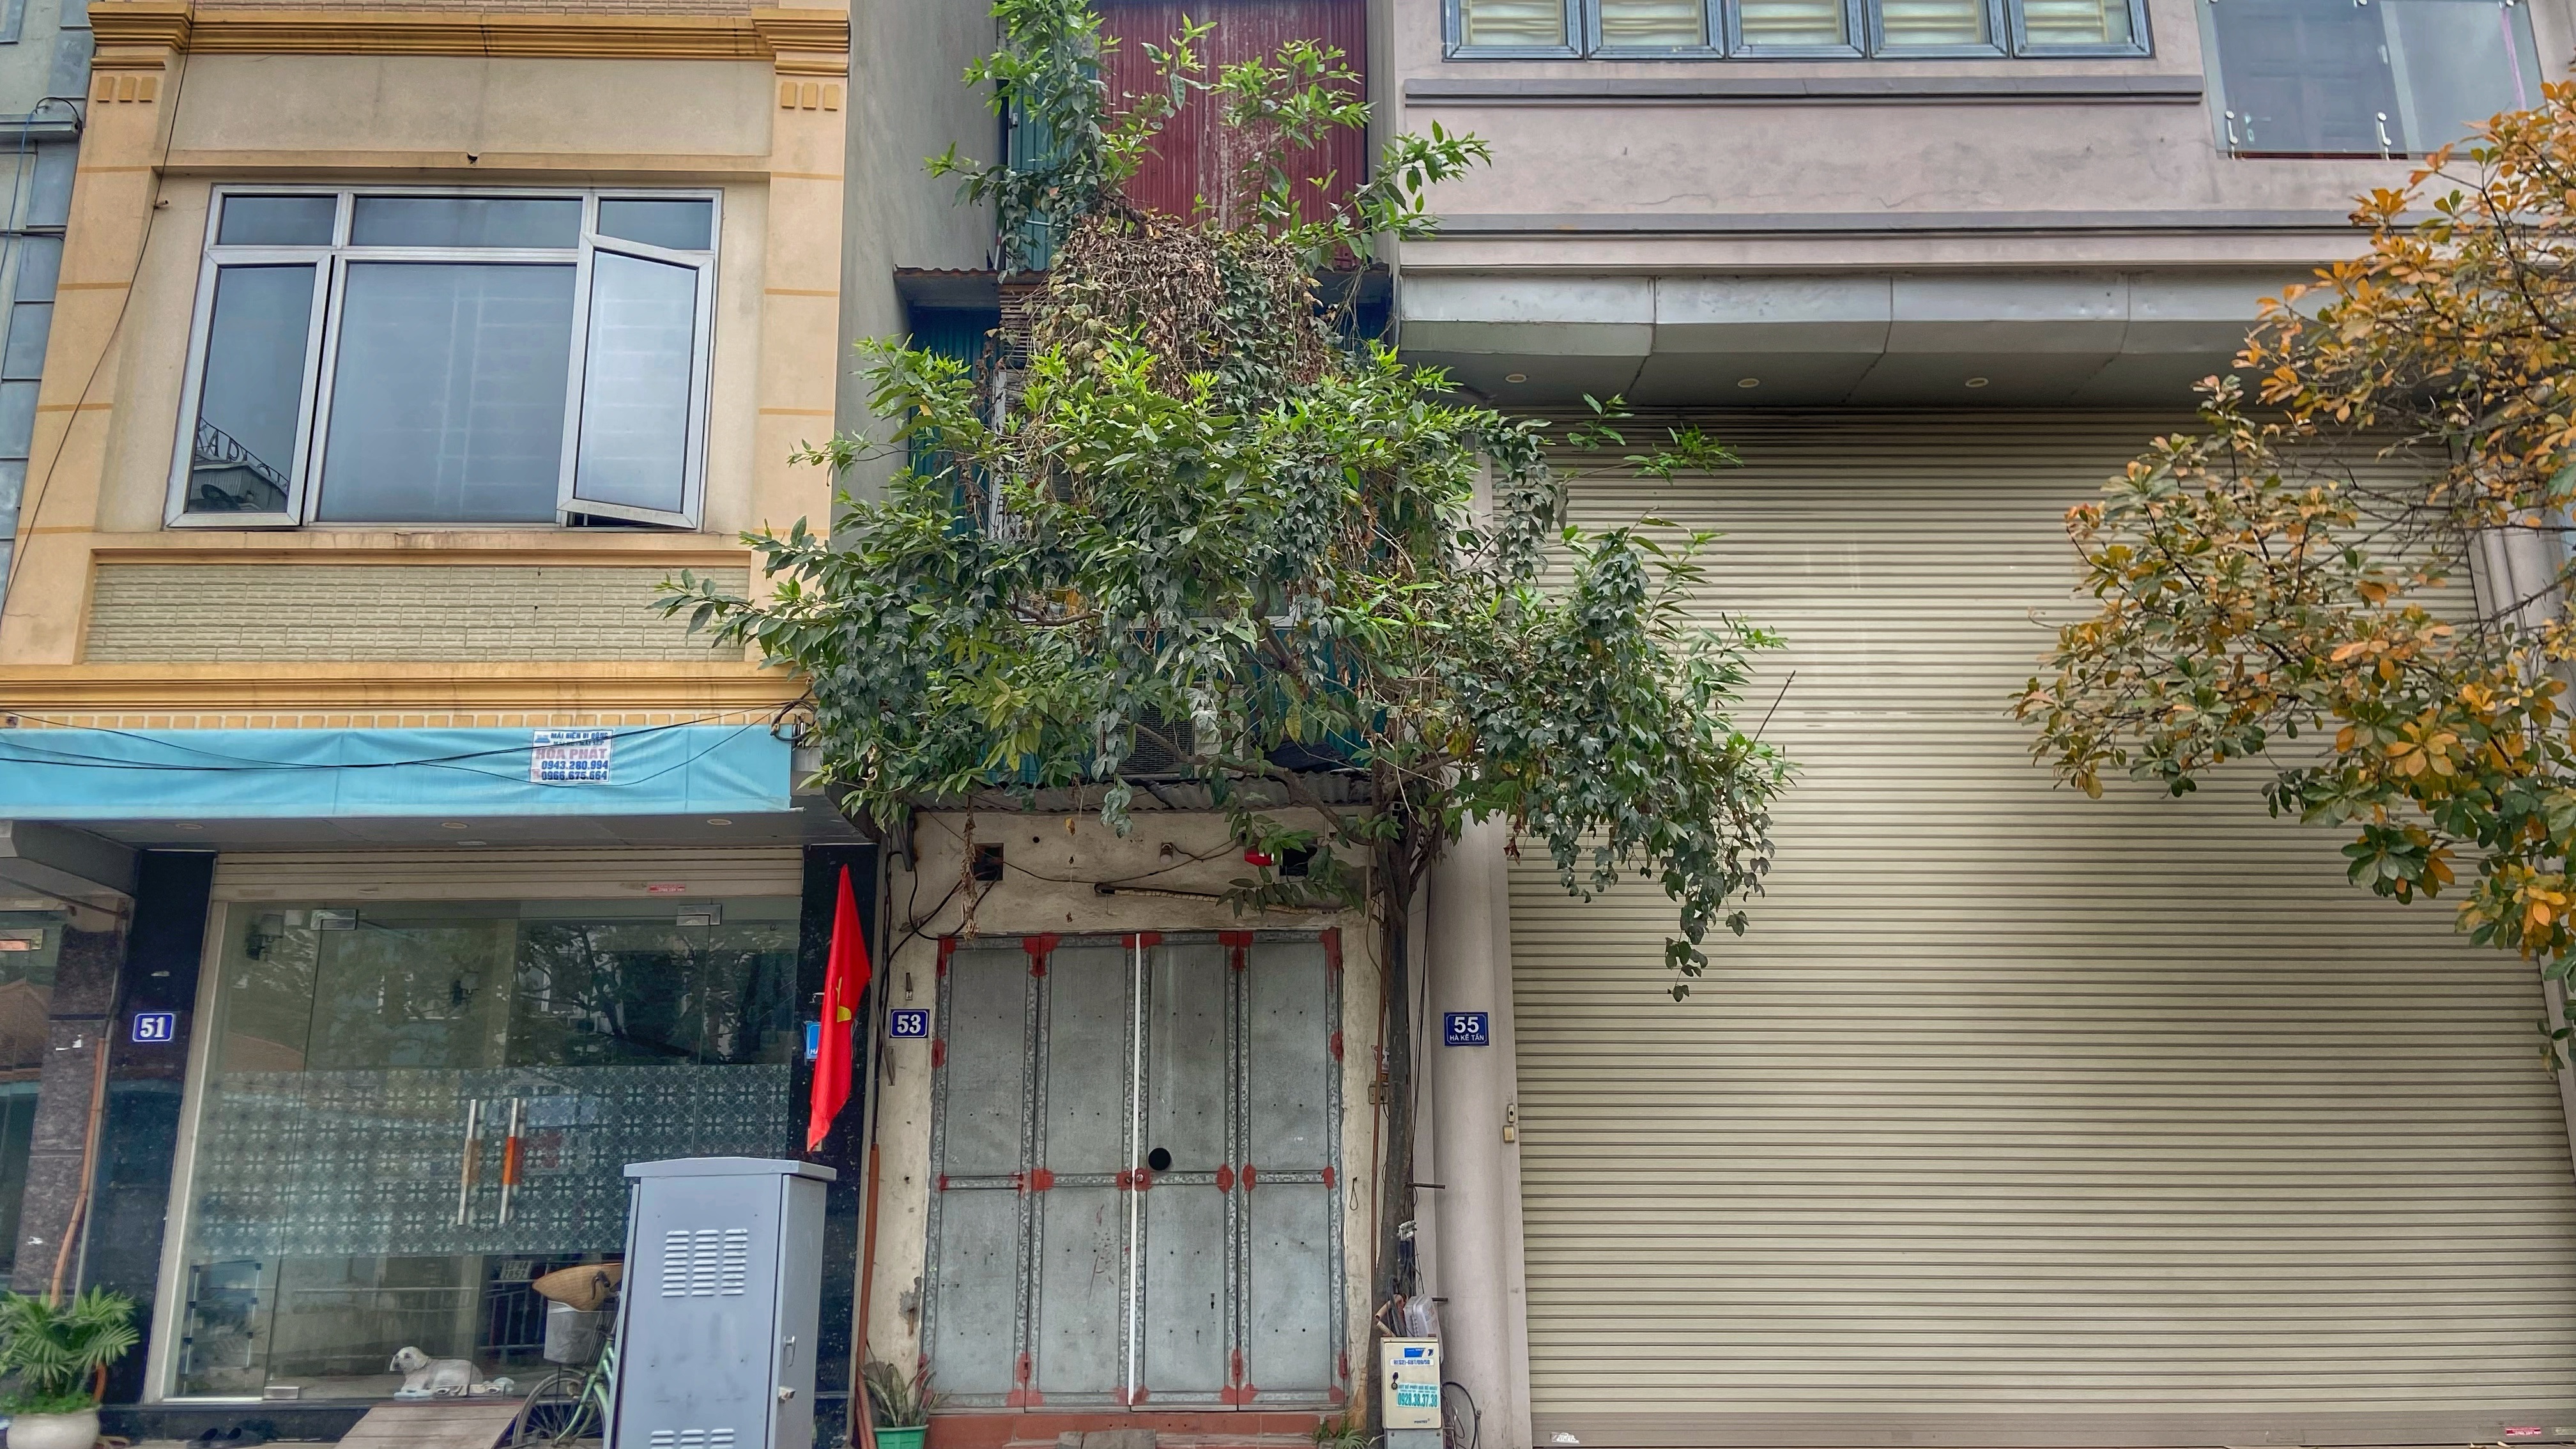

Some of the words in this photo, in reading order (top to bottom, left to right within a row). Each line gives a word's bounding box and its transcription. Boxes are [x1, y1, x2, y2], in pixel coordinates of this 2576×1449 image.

[140, 1017, 164, 1038] 51
[897, 1015, 921, 1034] 53
[1454, 1016, 1479, 1033] 55
[1398, 1392, 1438, 1407] 0928.38.37.38
